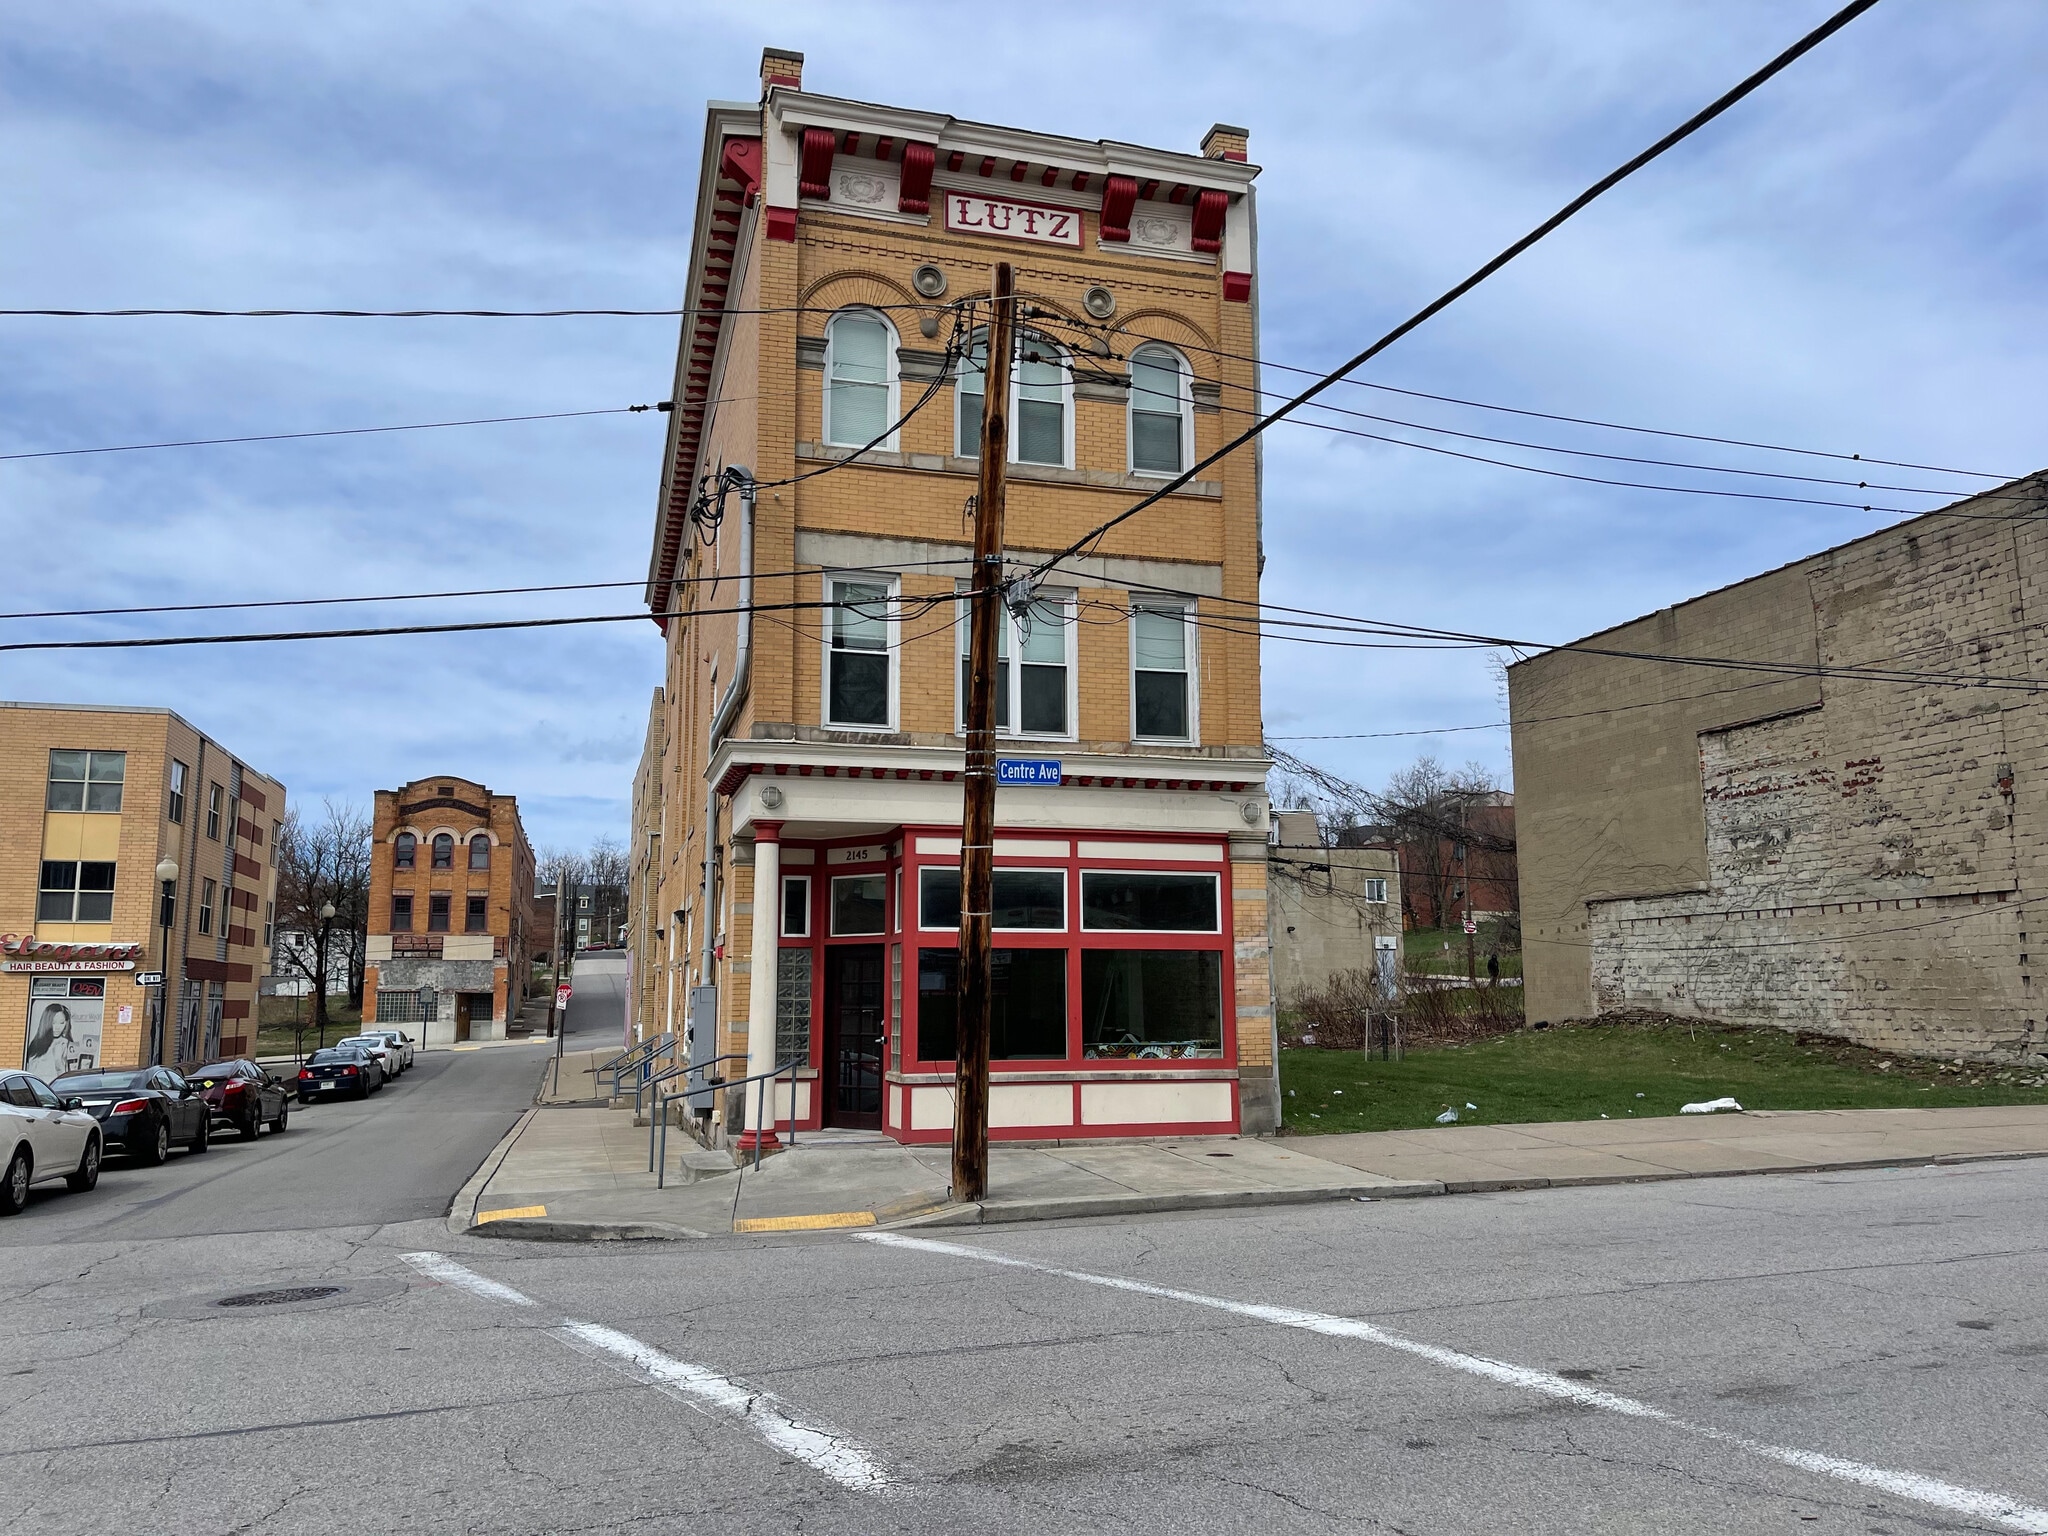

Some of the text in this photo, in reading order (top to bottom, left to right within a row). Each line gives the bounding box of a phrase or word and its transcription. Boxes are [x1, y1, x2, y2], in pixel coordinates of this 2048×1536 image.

[957, 199, 1071, 239] LUTZ
[1000, 763, 1058, 779] Centre Ave
[846, 850, 868, 861] 2145
[0, 933, 143, 961] Elegant
[35, 962, 73, 970] BEAUTY
[84, 961, 125, 970] FASHION
[72, 983, 101, 996] OPEN
